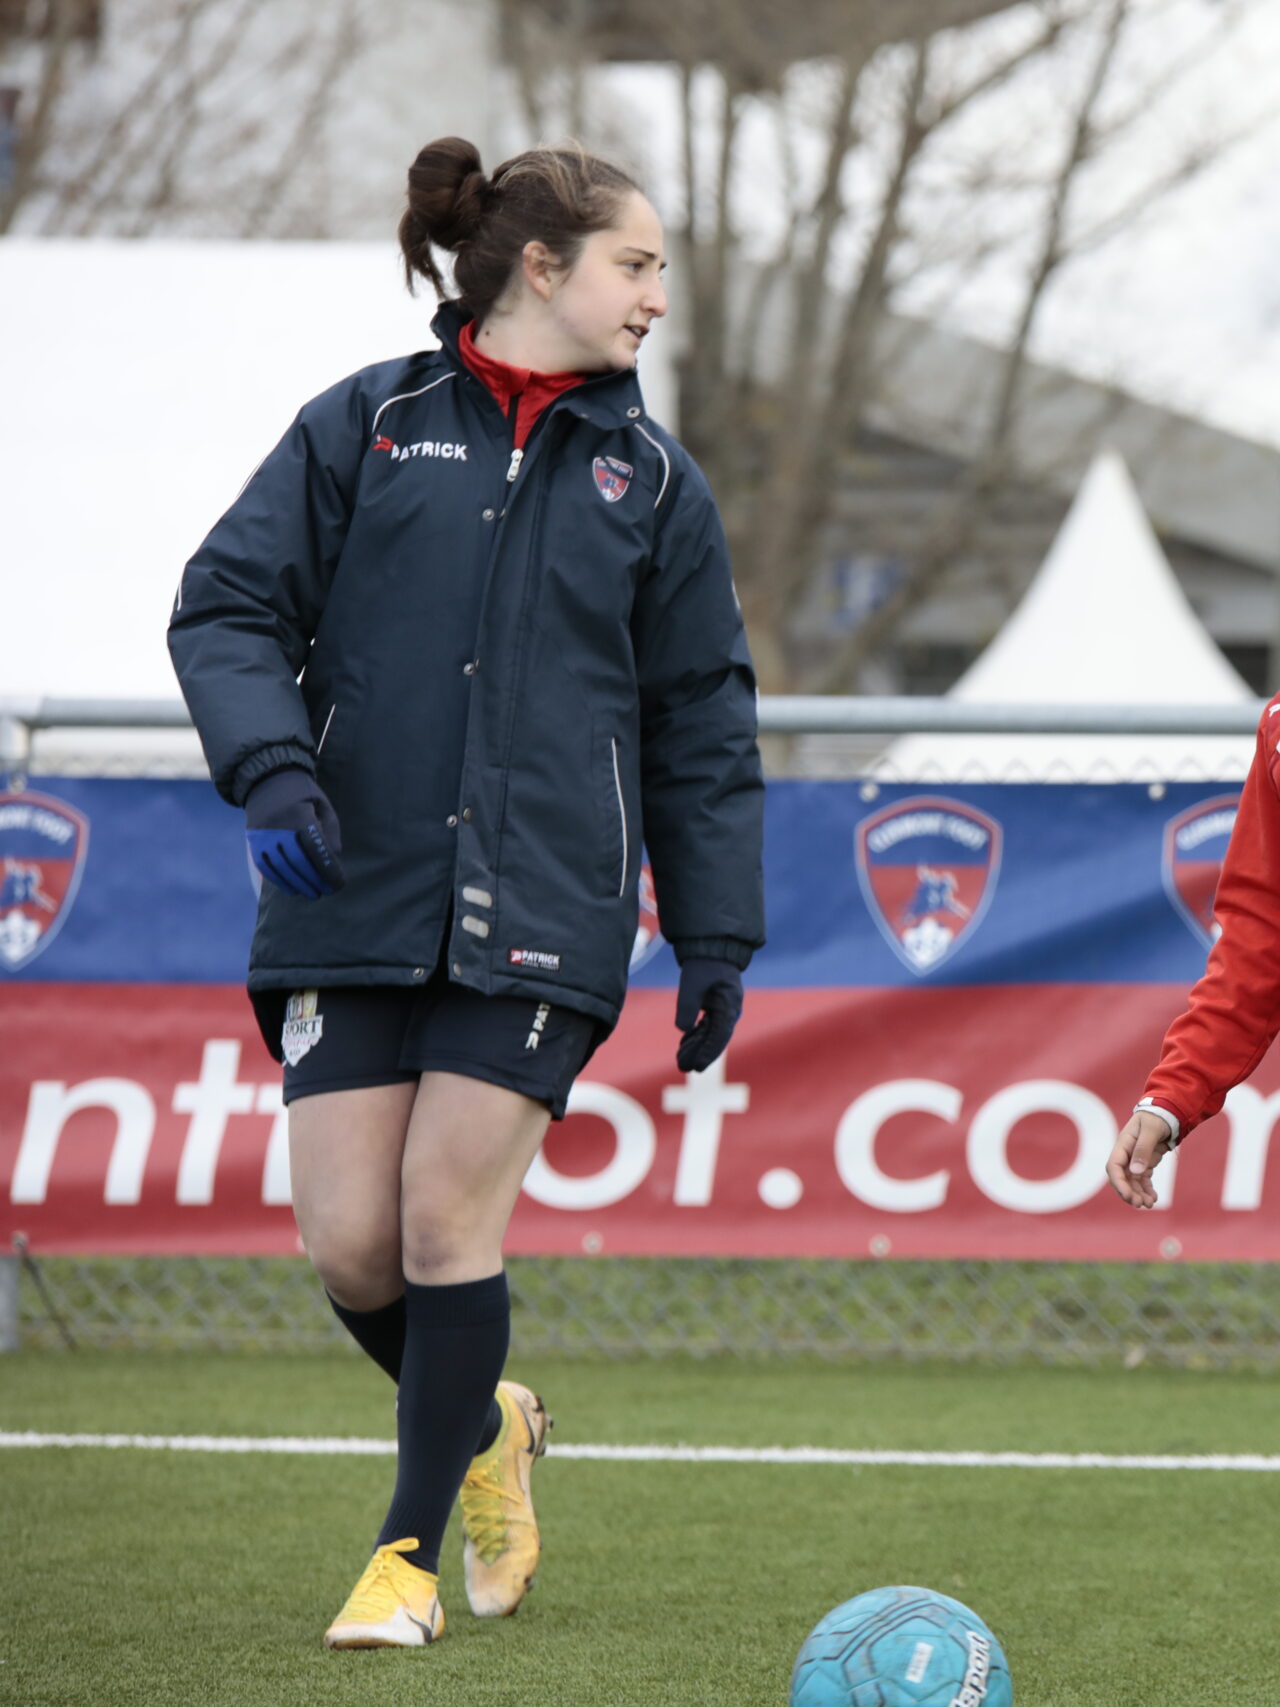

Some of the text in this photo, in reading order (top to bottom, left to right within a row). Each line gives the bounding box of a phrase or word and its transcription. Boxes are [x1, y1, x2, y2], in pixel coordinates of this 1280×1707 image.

[391, 440, 468, 462] PATRICK
[522, 949, 560, 966] PATRICK
[946, 1629, 991, 1707] sport
